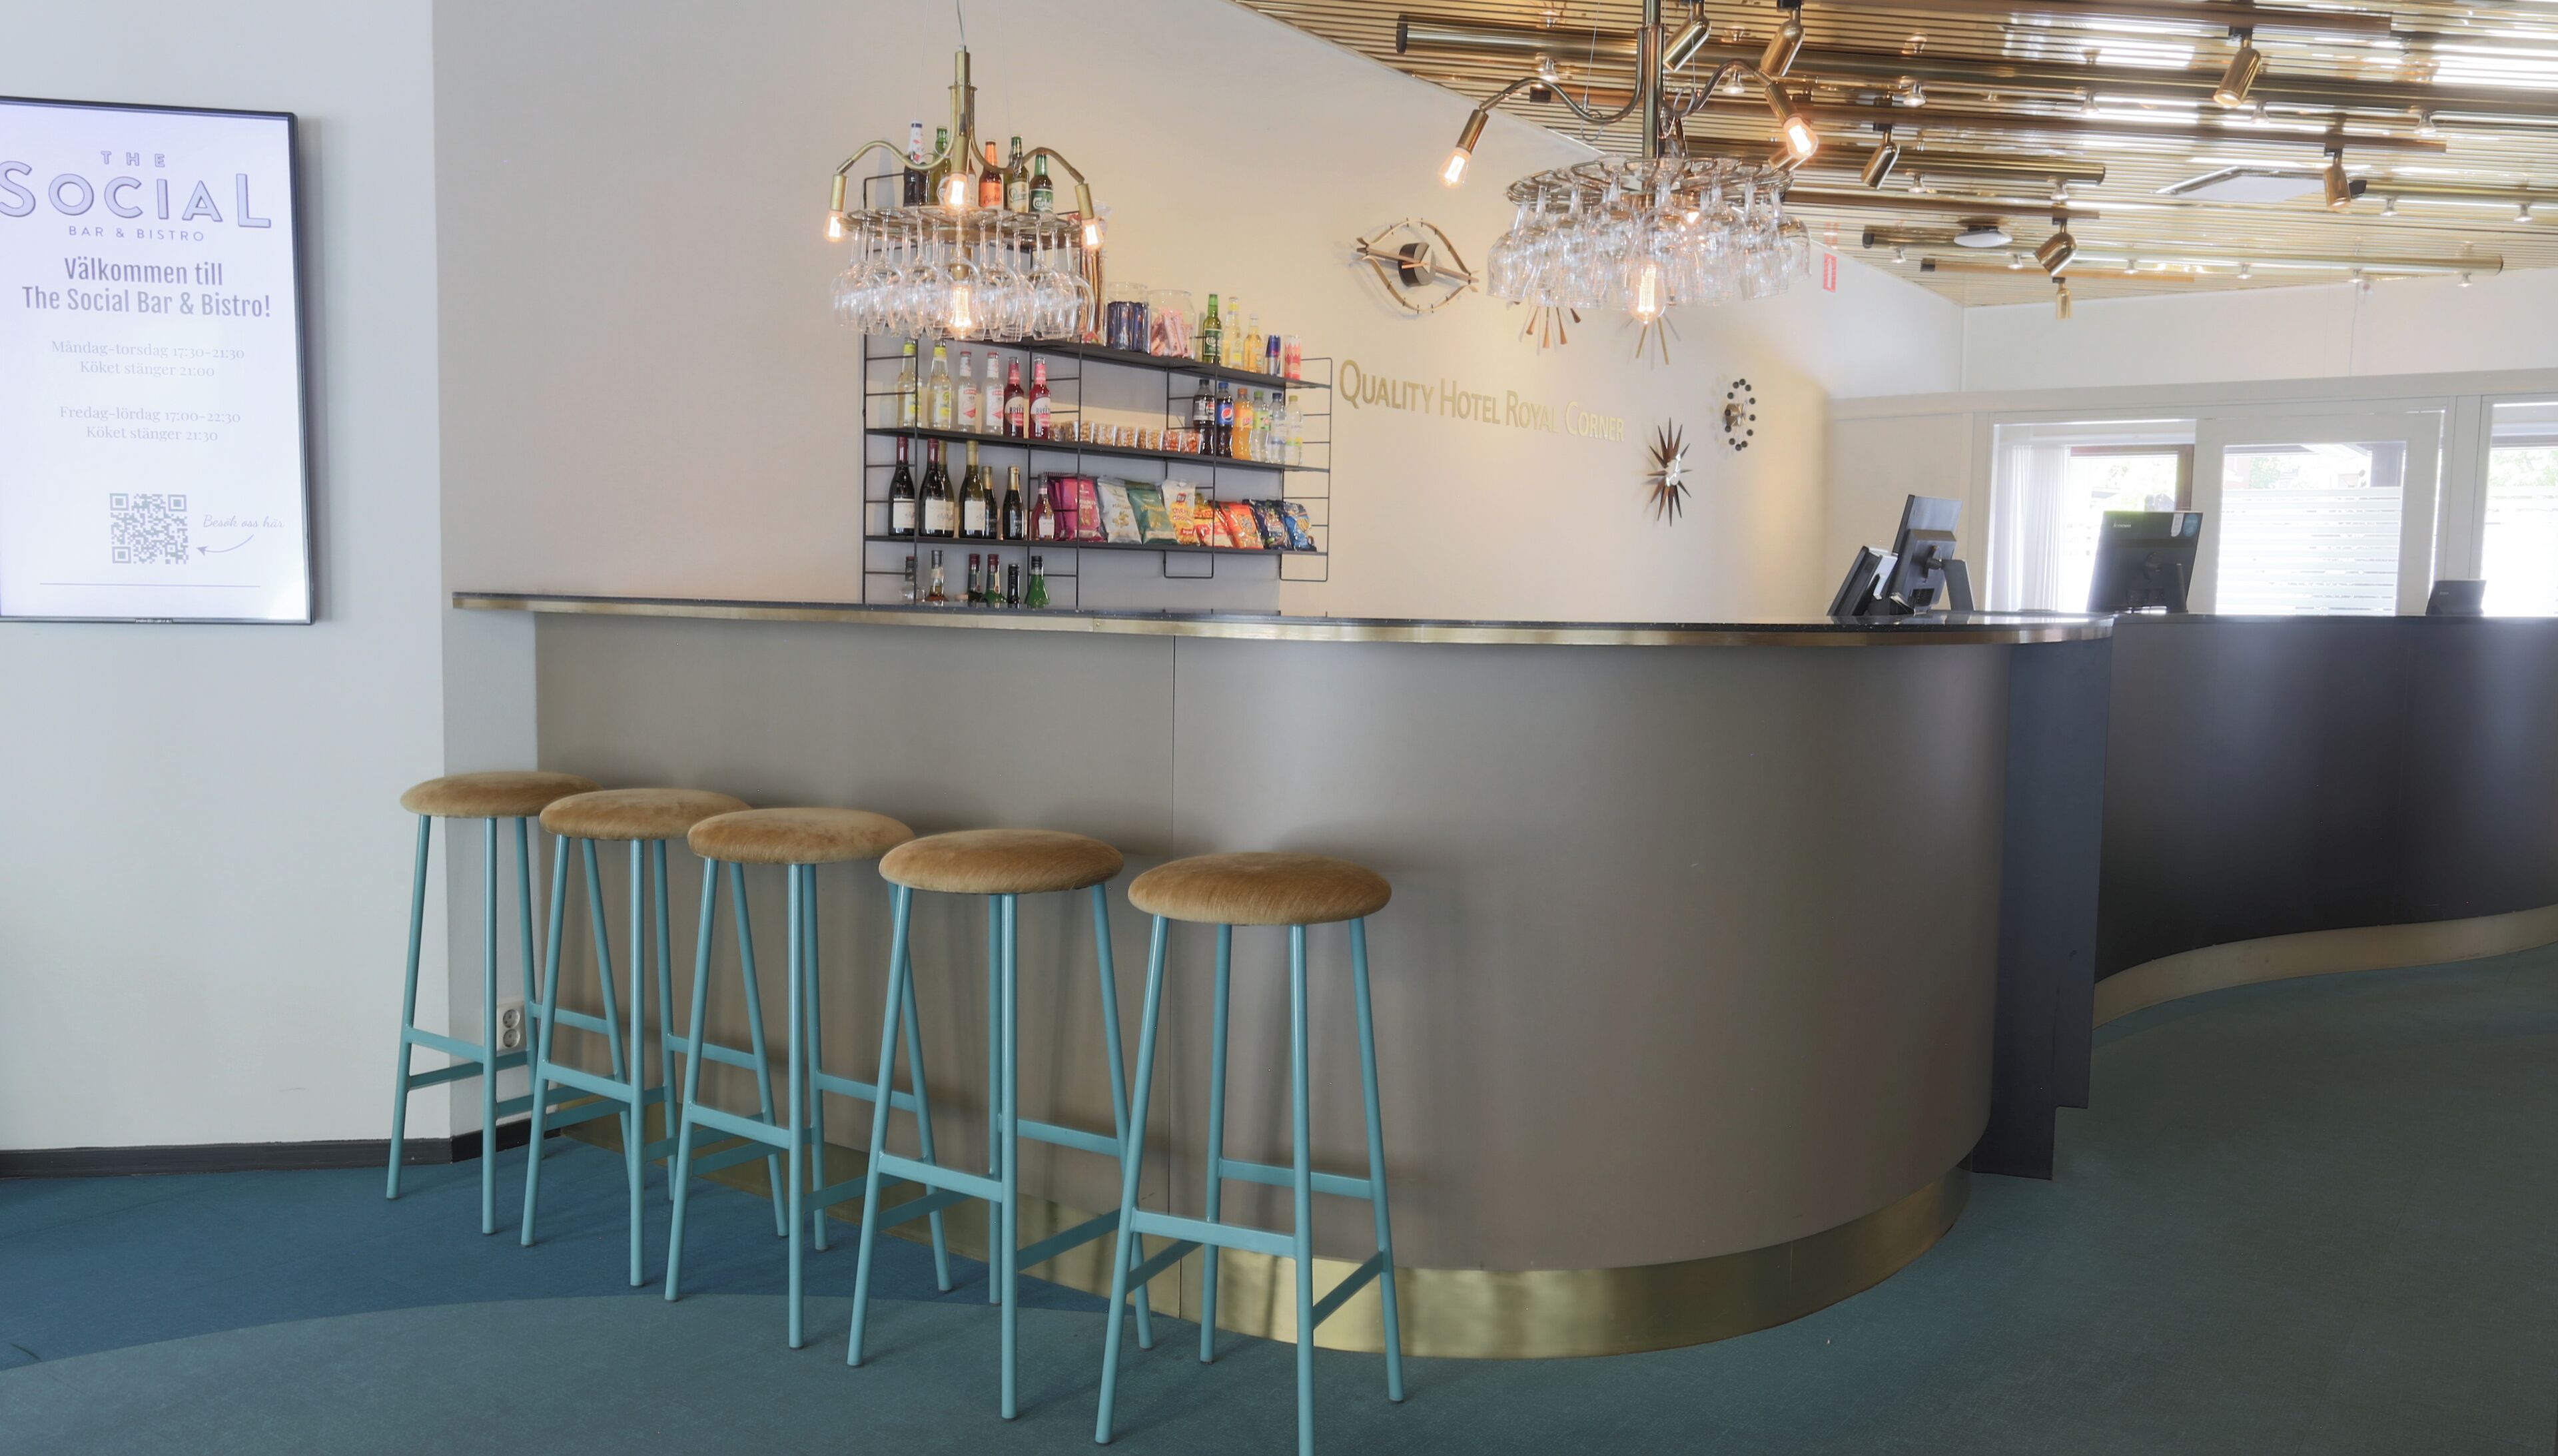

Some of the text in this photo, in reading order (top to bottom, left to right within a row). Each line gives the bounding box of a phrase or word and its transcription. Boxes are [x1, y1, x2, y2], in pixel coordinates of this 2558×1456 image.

[101, 151, 167, 168] THE
[0, 161, 272, 228] SOCIAL
[69, 226, 205, 242] BAR & BISTRO
[64, 256, 224, 286] Välkommen till
[22, 286, 271, 318] The Social Bar & Bistro!
[173, 346, 245, 360] 17:30-21:30
[80, 360, 215, 378] Köket stänger 21:00
[1339, 359, 1625, 443] QUALITY HOTEL ROYAL CORNER
[165, 411, 241, 424] 17:00-22:30
[86, 426, 218, 442] Köket stänger 21:30
[203, 515, 238, 528] Besök
[262, 515, 284, 529] här
